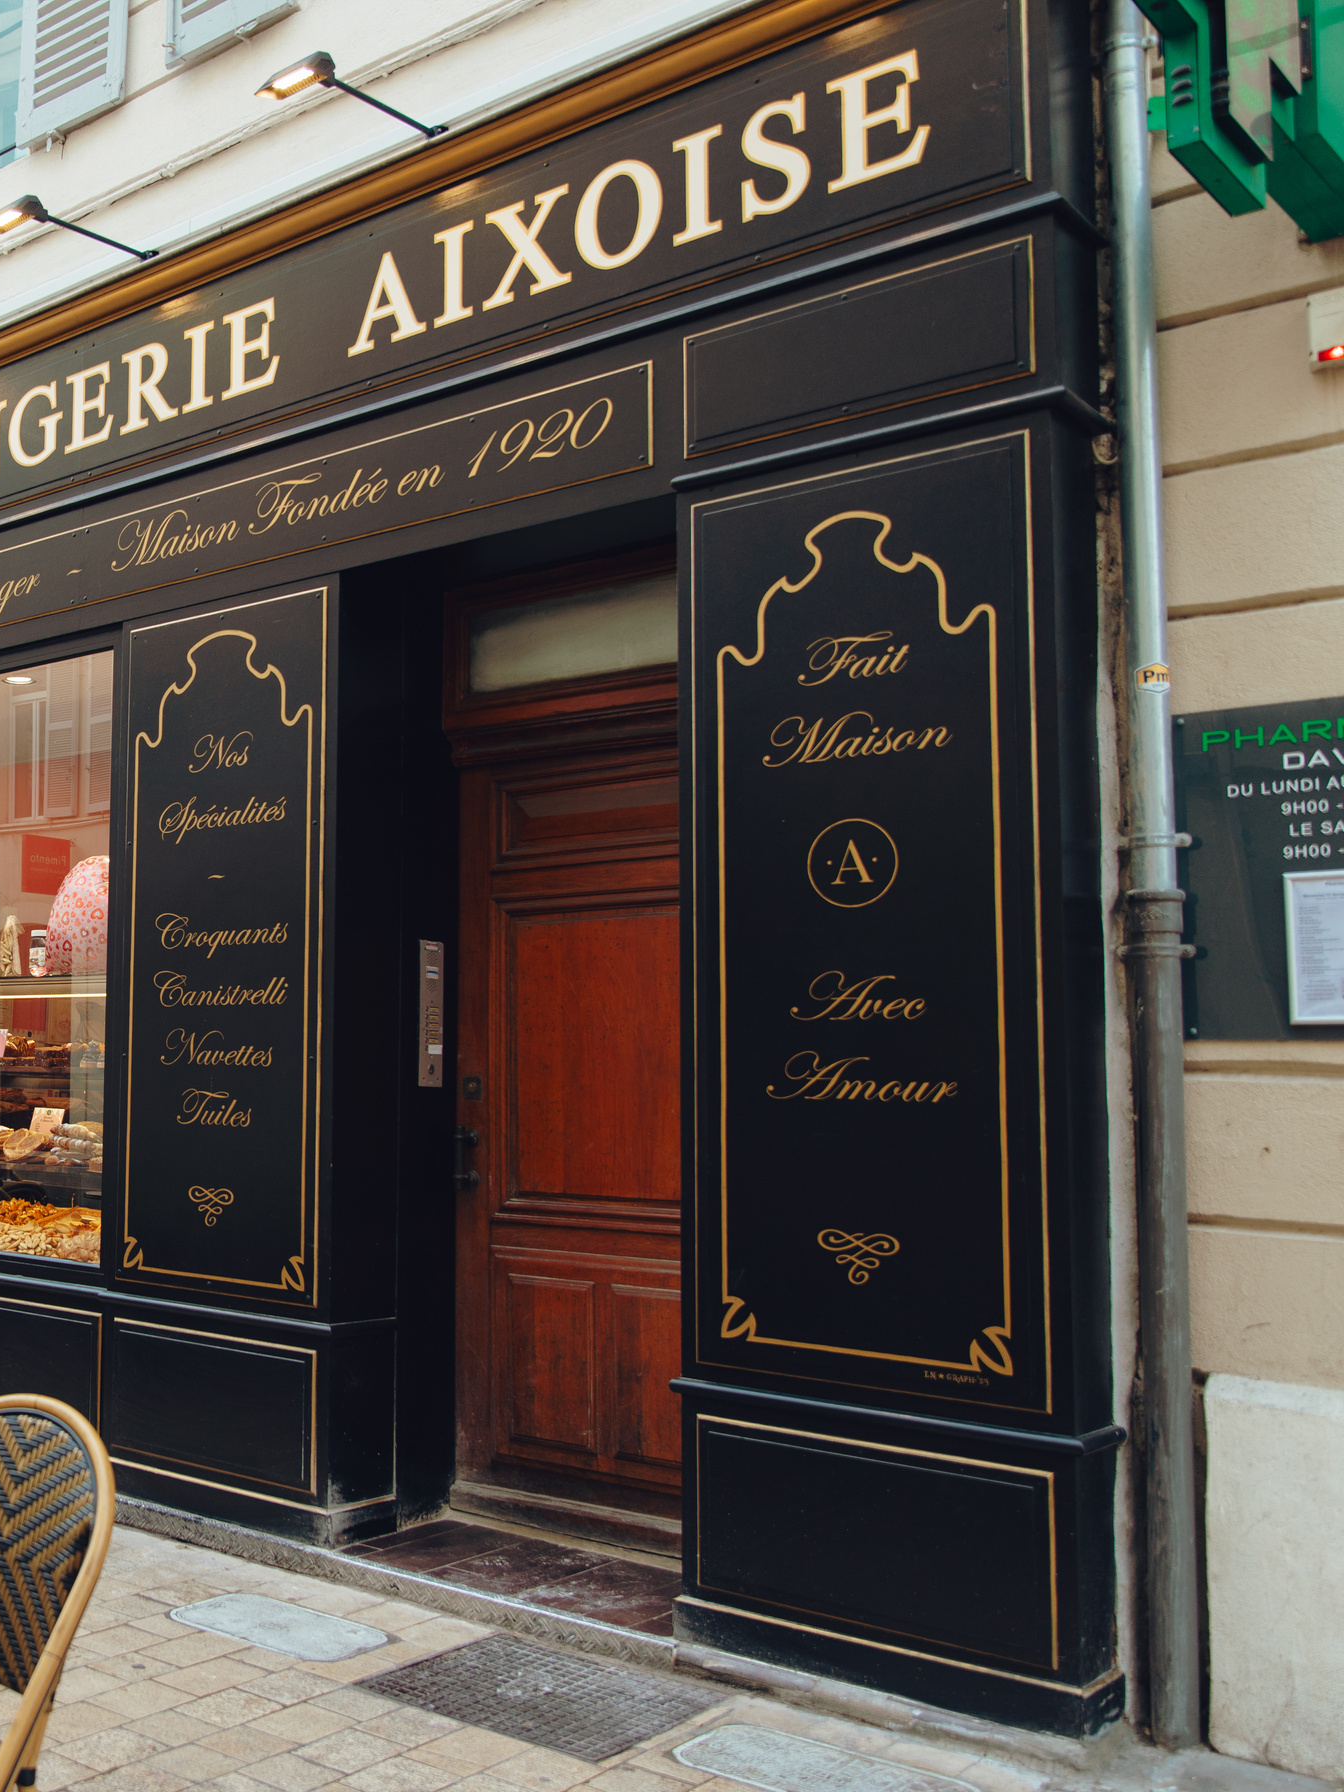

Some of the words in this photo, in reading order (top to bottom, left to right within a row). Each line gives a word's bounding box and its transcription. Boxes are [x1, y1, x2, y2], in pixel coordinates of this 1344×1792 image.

[348, 49, 930, 358] AIXOISE
[111, 509, 240, 572] Maison
[248, 468, 388, 534] Fondée
[396, 464, 445, 496] en
[467, 398, 613, 478] 1920
[798, 631, 910, 687] Fait
[189, 731, 254, 773] Nos
[762, 711, 953, 768] Maison
[1201, 717, 1344, 752] PHAR
[1227, 782, 1254, 799] DU
[1260, 776, 1320, 796] LUNDI
[1326, 774, 1344, 790] A
[1281, 798, 1330, 817] 9H00
[158, 796, 287, 844] Spécialités
[1289, 821, 1313, 838] LE
[1282, 842, 1332, 860] 9H00
[155, 913, 288, 959] Croquants
[153, 970, 288, 1007] Canistrelli
[790, 970, 927, 1020] Avec
[160, 1028, 273, 1067] Navettes
[766, 1050, 957, 1103] Amour
[176, 1088, 252, 1127] Tuiles
